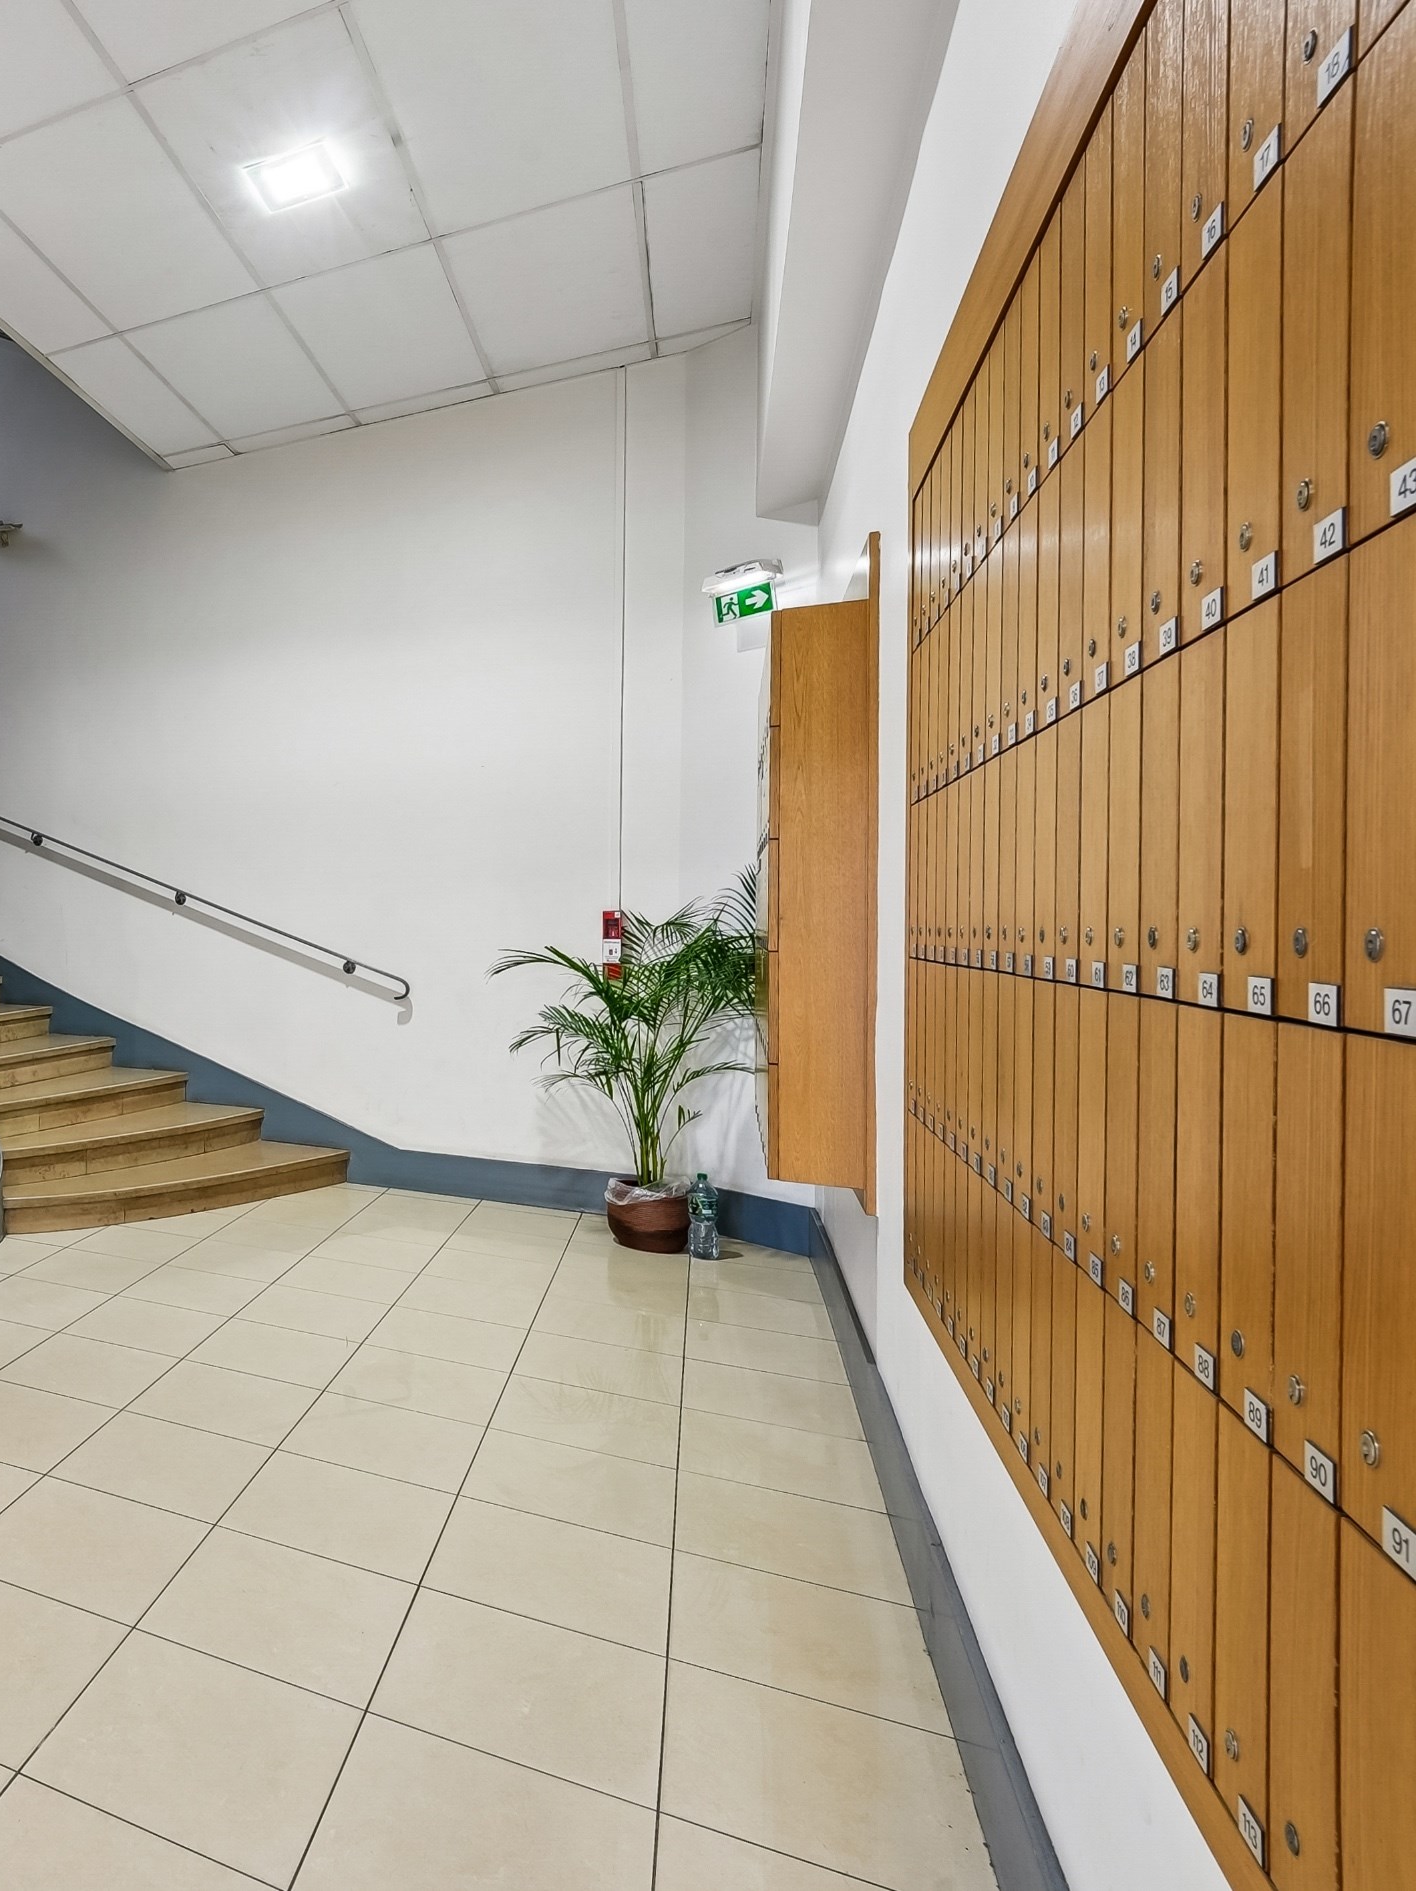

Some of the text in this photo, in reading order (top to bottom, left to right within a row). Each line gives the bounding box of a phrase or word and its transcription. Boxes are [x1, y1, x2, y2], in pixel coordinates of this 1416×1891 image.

[1259, 144, 1271, 172] 17
[1206, 219, 1216, 243] 16
[1165, 281, 1173, 303] 15
[1130, 334, 1137, 350] 14
[1320, 522, 1335, 548] 42
[1257, 564, 1269, 586] 41
[1205, 598, 1216, 620] 40
[1162, 627, 1172, 647] 39
[1128, 650, 1135, 668] 38
[1097, 670, 1104, 687] 37
[1094, 967, 1101, 982] 61
[1125, 970, 1133, 986] 62
[1159, 974, 1170, 991] 63
[1201, 980, 1213, 999] 64
[1252, 985, 1265, 1006] 65
[1314, 992, 1331, 1016] 66
[1392, 999, 1412, 1025] 67
[1065, 1238, 1072, 1254] 84
[1091, 1260, 1099, 1278] 85
[1121, 1286, 1130, 1306] 86
[1156, 1317, 1166, 1338] 87
[1198, 1354, 1209, 1379] 88
[1248, 1401, 1262, 1428] 89
[1310, 1455, 1327, 1487] 90
[1392, 1527, 1409, 1563] 91
[1087, 1550, 1096, 1576] 109
[1117, 1601, 1126, 1626] 110
[1152, 1661, 1161, 1687] 111
[1191, 1729, 1204, 1762] 112
[1242, 1813, 1257, 1850] 113
